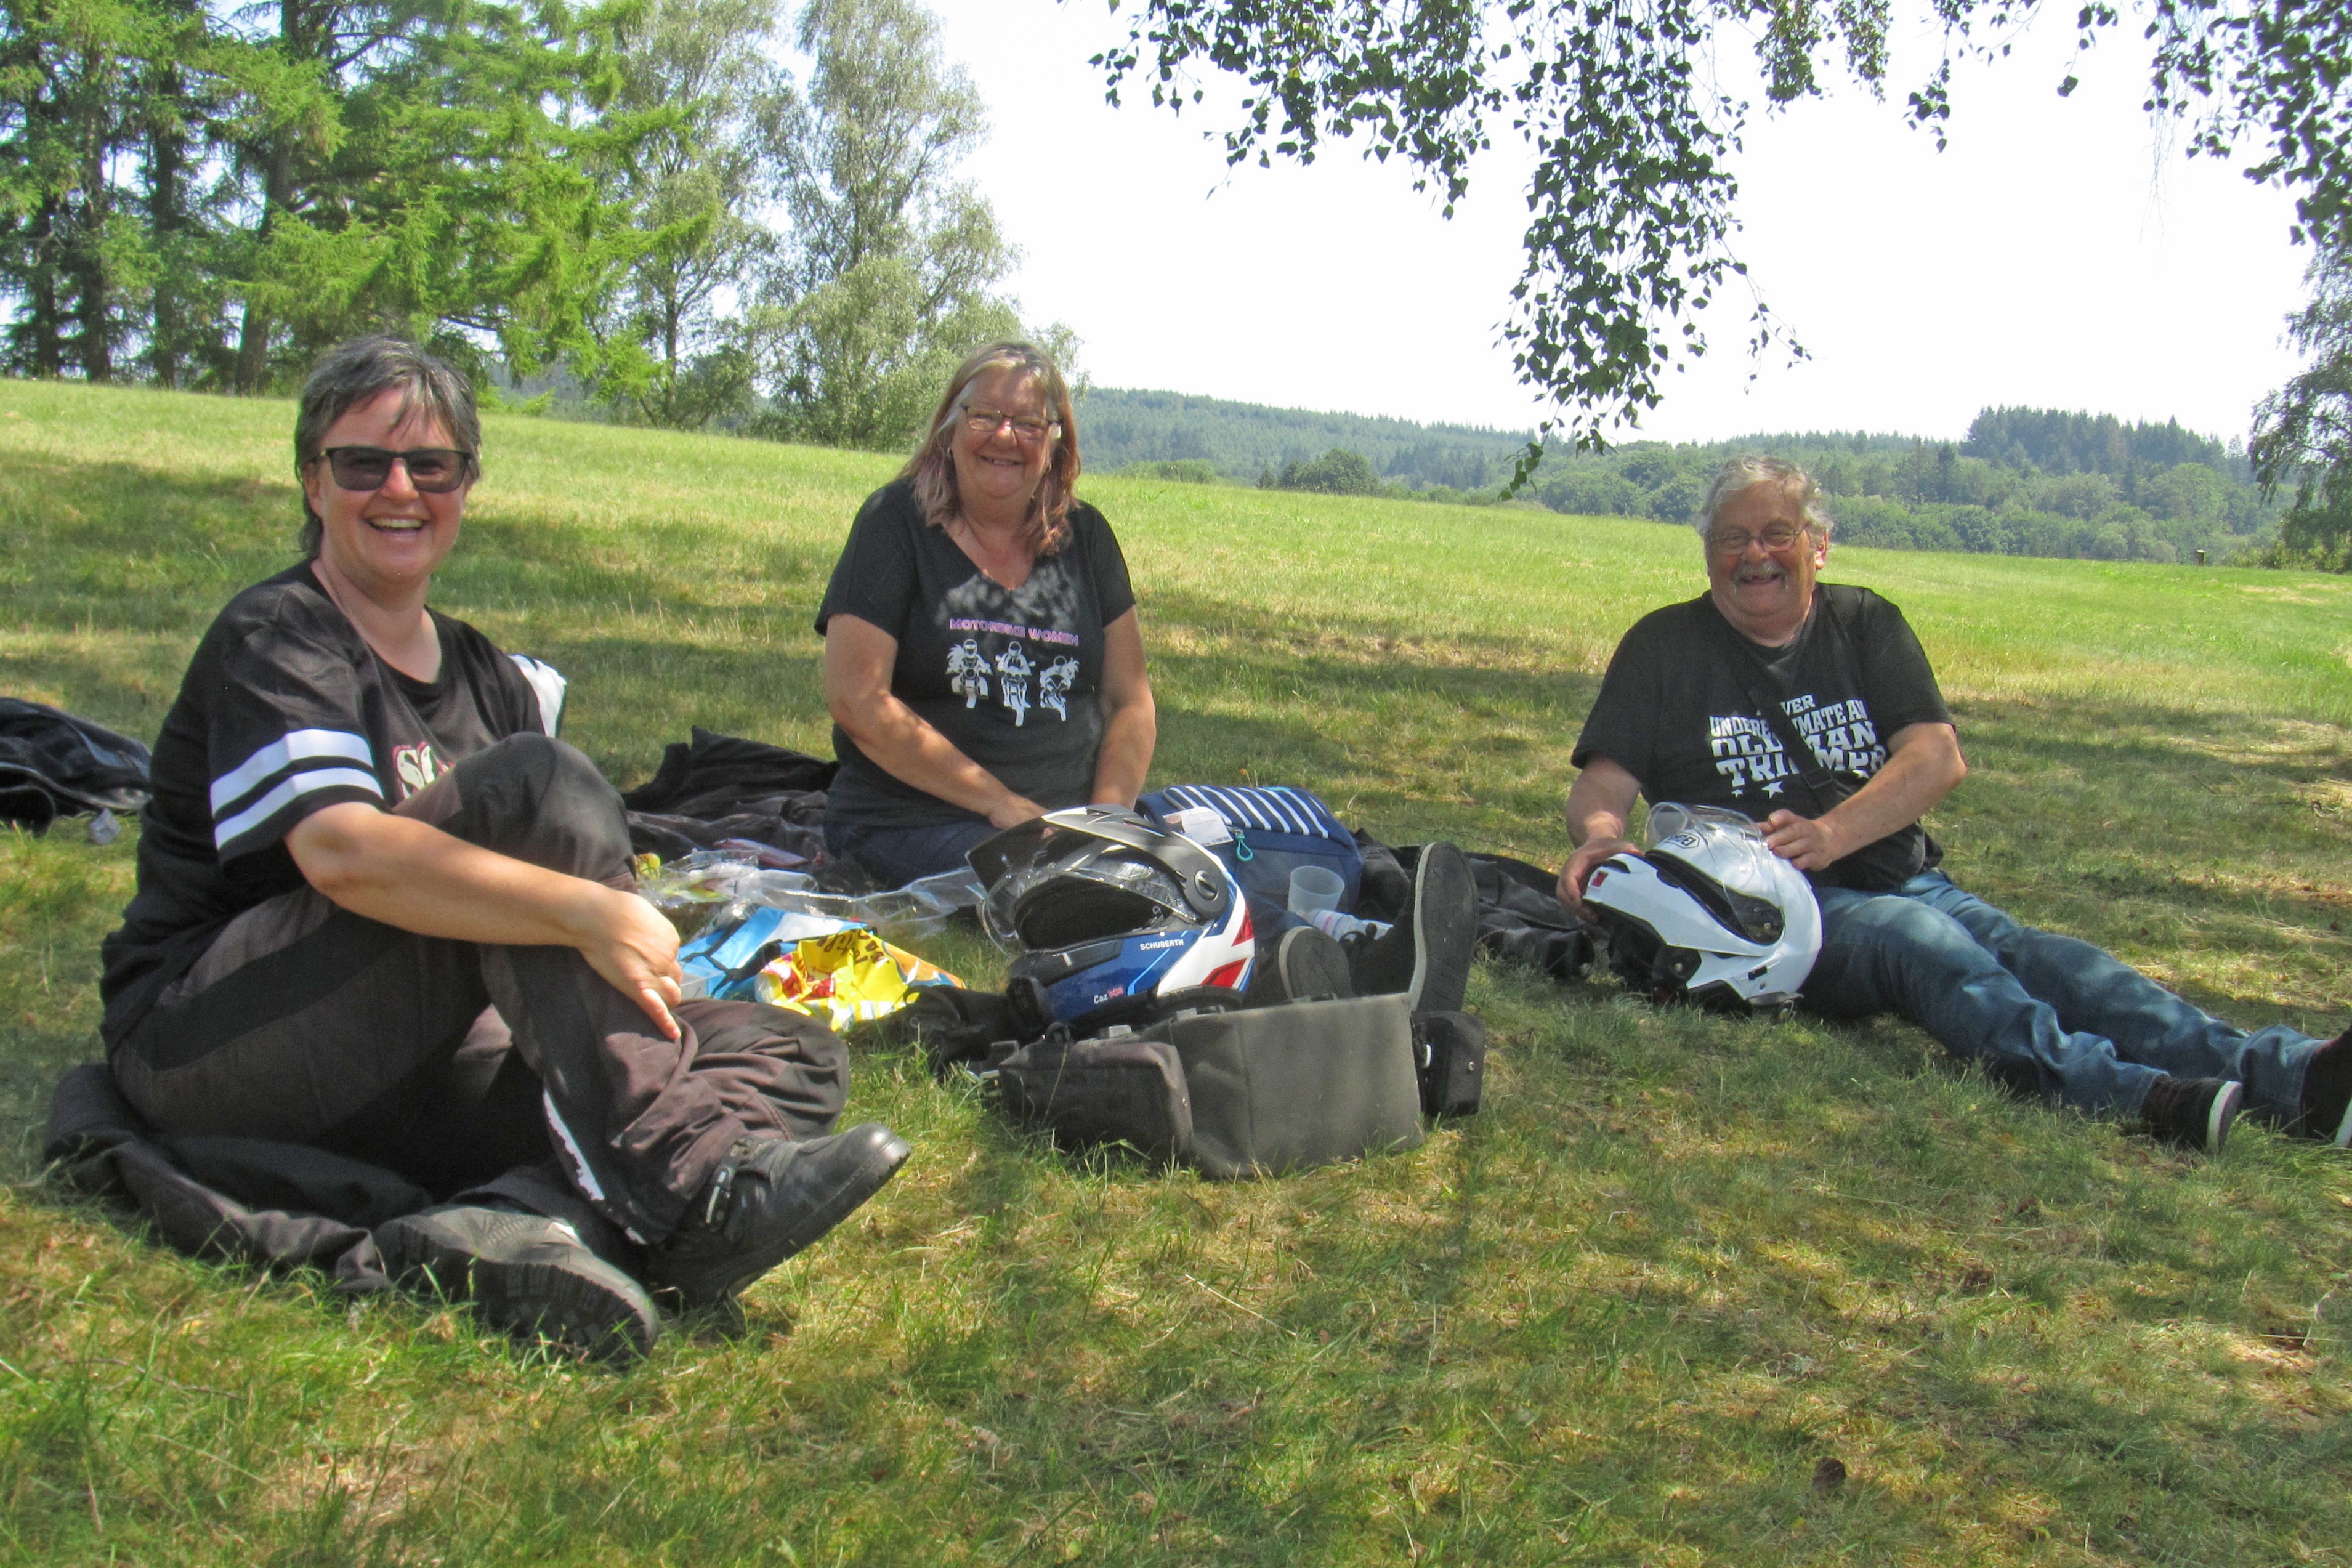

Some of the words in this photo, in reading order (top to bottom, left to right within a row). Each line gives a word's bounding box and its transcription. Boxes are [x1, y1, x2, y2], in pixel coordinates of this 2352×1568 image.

[949, 619, 1025, 638] MOTORBIKE
[1028, 628, 1079, 647] WOMEN
[1139, 938, 1184, 950] SCHUBERTH
[1093, 993, 1109, 1004] Caz
